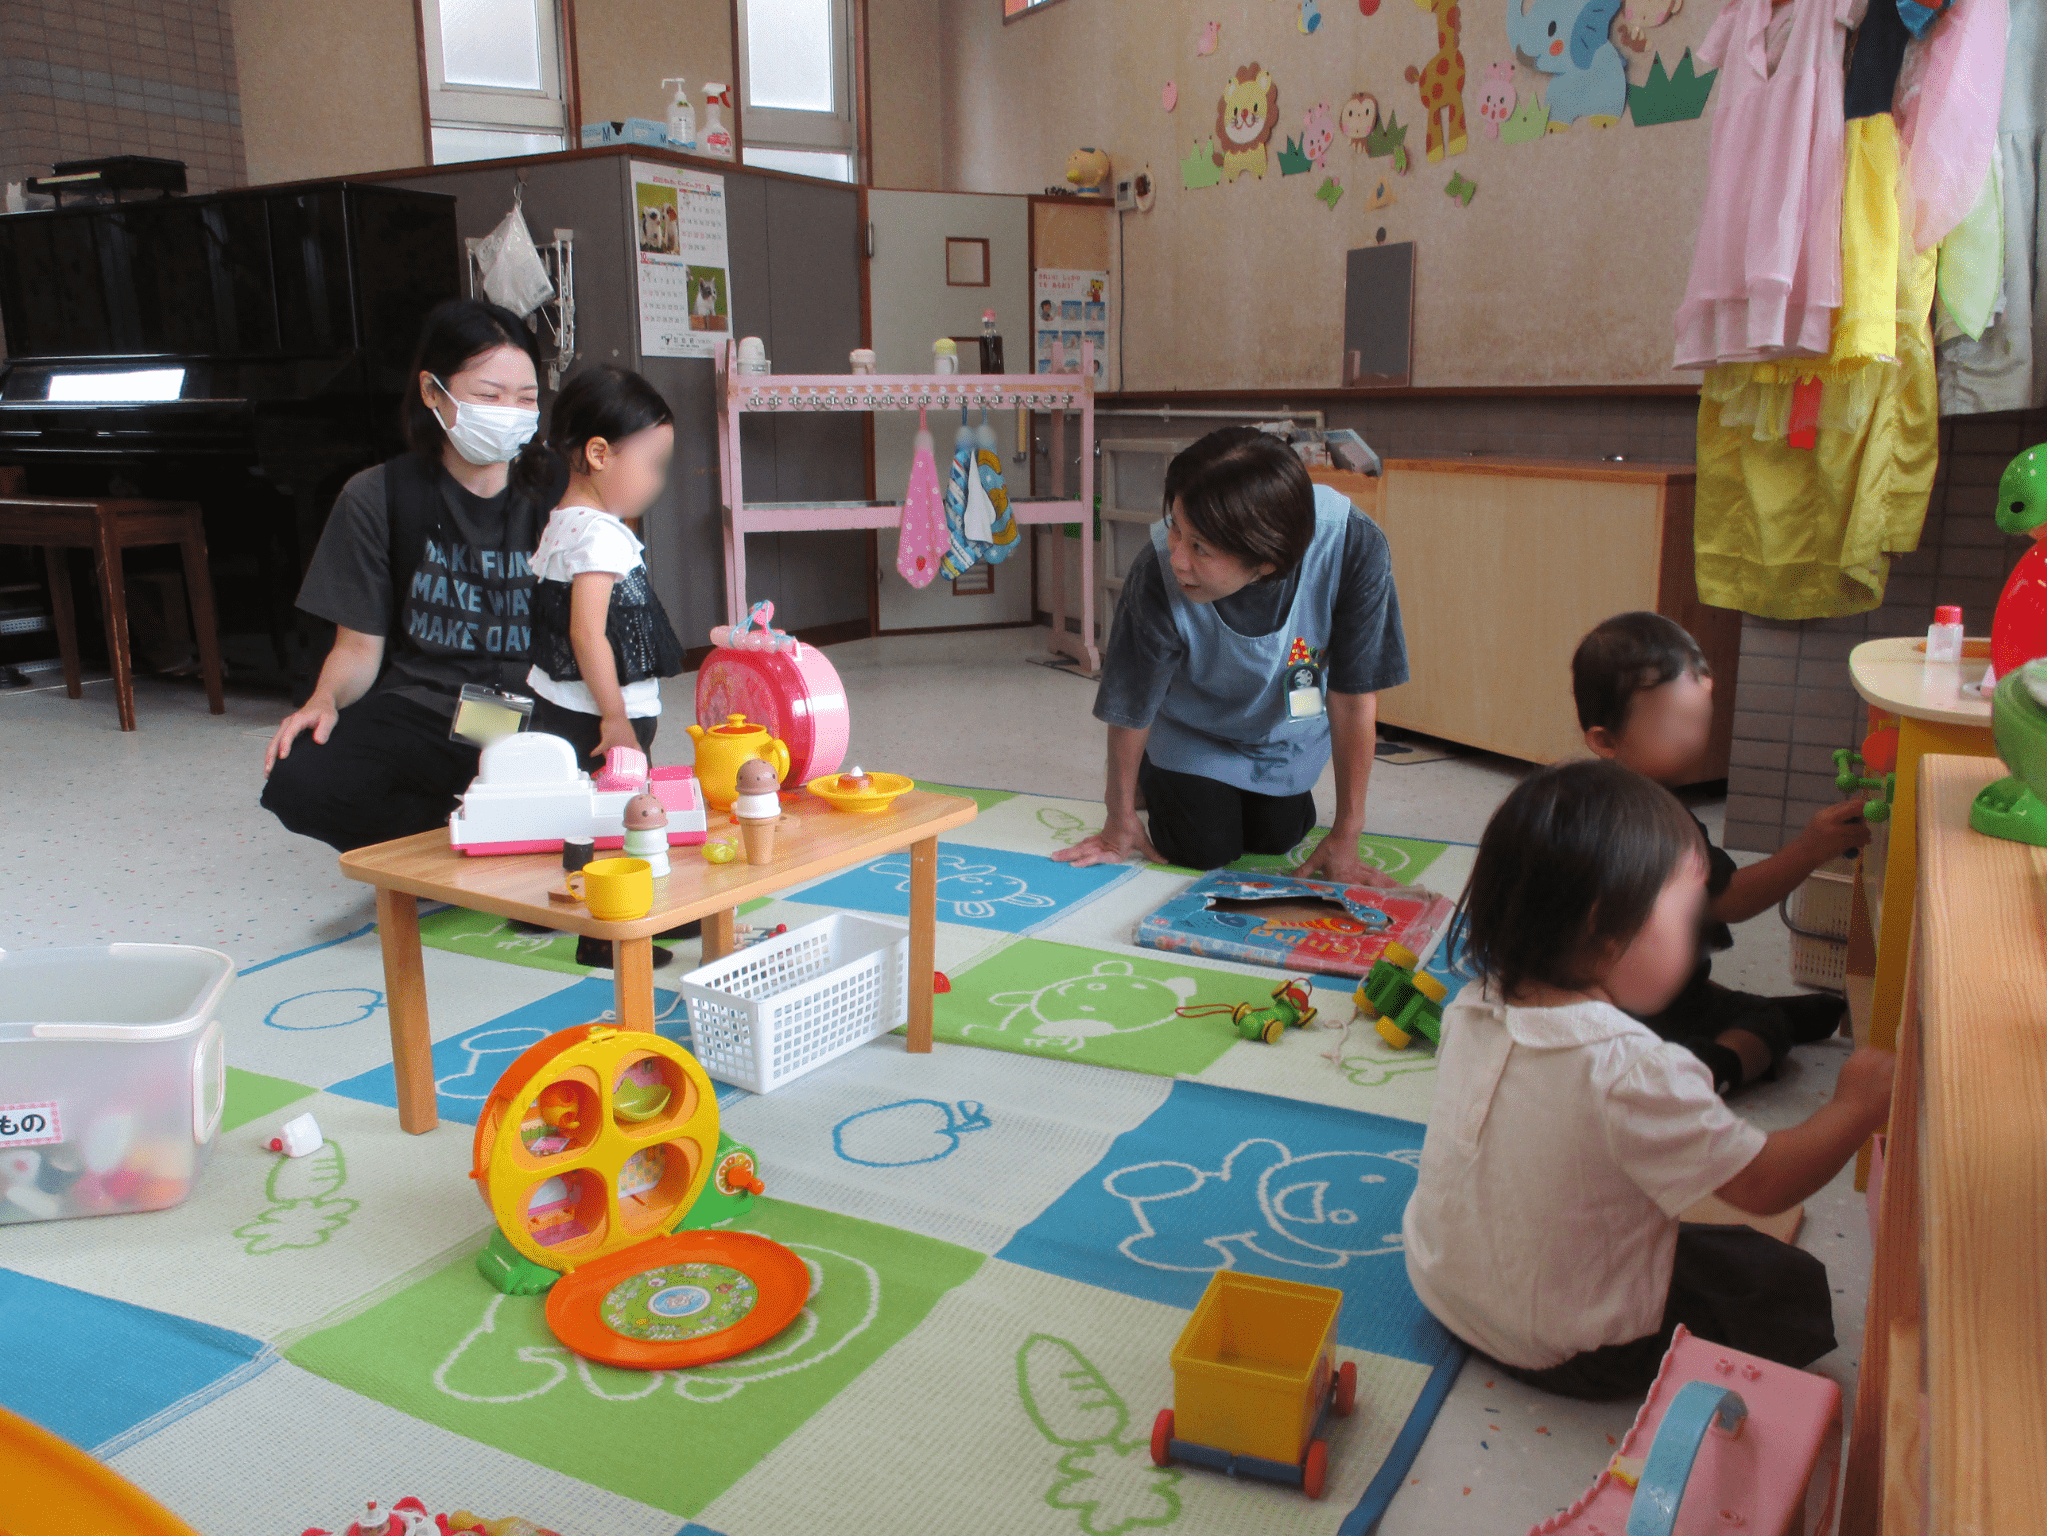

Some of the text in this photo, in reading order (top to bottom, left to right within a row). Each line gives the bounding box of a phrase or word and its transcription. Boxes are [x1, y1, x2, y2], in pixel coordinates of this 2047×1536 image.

[602, 125, 611, 142] M
[660, 133, 667, 144] M
[481, 550, 534, 579] FUN
[412, 571, 482, 613] MAKE
[409, 608, 479, 651] MAKE
[0, 1114, 47, 1136] もの
